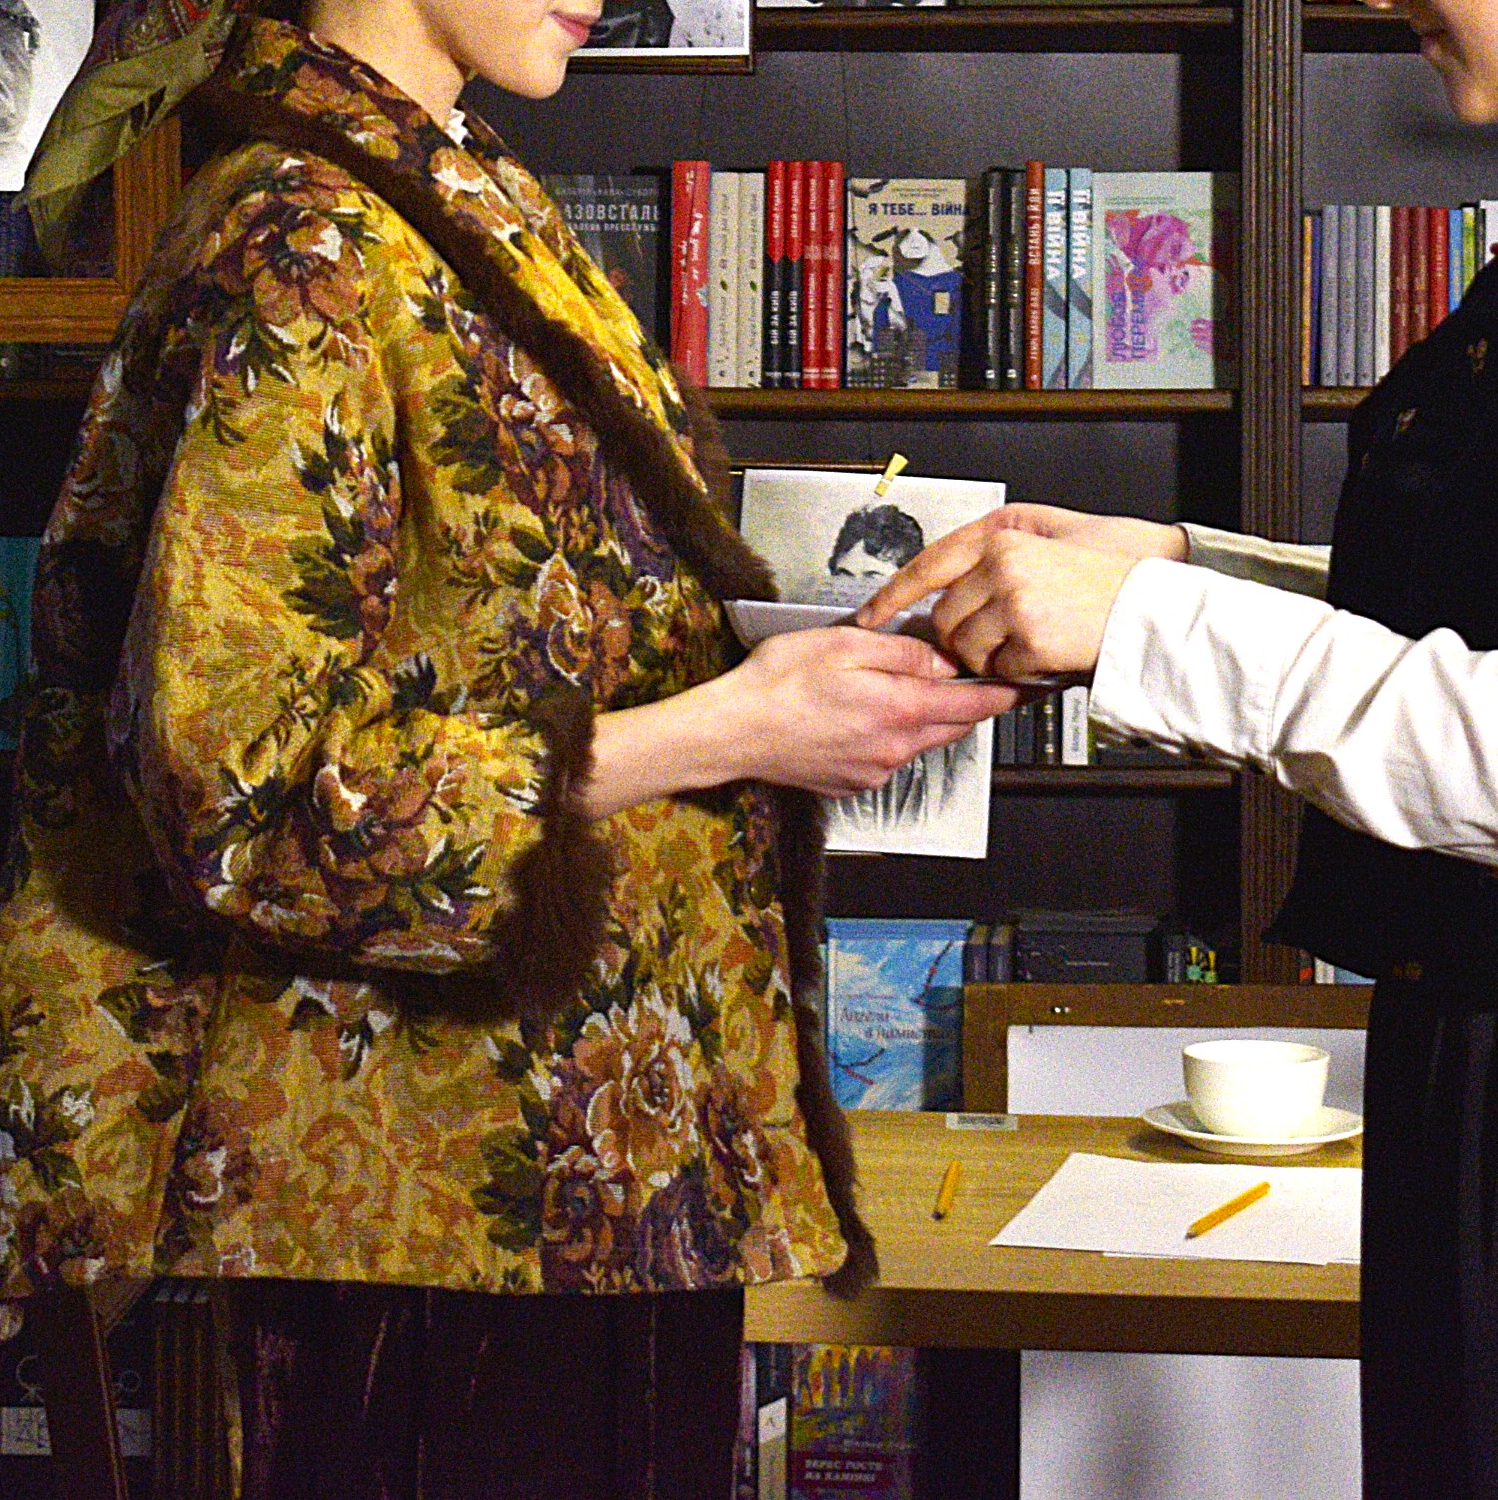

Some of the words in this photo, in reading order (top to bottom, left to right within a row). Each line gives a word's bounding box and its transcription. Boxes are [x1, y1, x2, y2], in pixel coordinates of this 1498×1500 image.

[868, 203, 878, 216] Я
[931, 203, 969, 216] ВІЙНА
[1046, 211, 1066, 280] ВІЙНА
[1072, 211, 1090, 280] ВІЙНА
